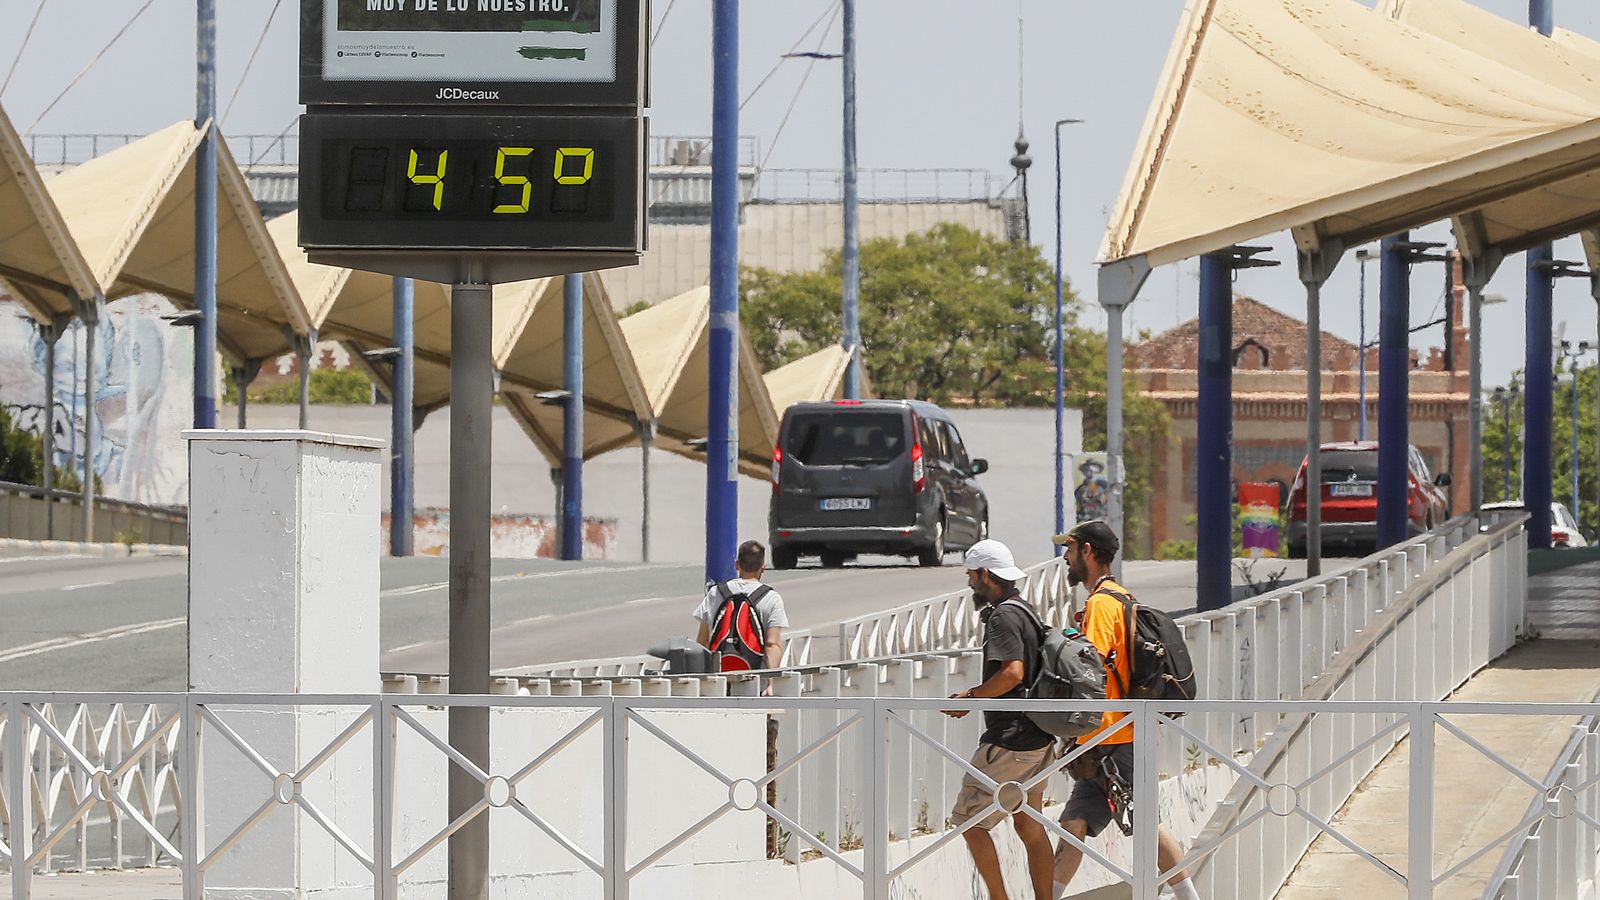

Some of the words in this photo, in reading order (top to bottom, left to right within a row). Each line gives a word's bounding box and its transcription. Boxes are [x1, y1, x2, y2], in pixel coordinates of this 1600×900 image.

[366, 0, 406, 11] MUY
[415, 0, 438, 11] DE
[446, 0, 469, 11] LO
[477, 0, 569, 11] NUESTRO.
[435, 87, 500, 100] JCDecaux
